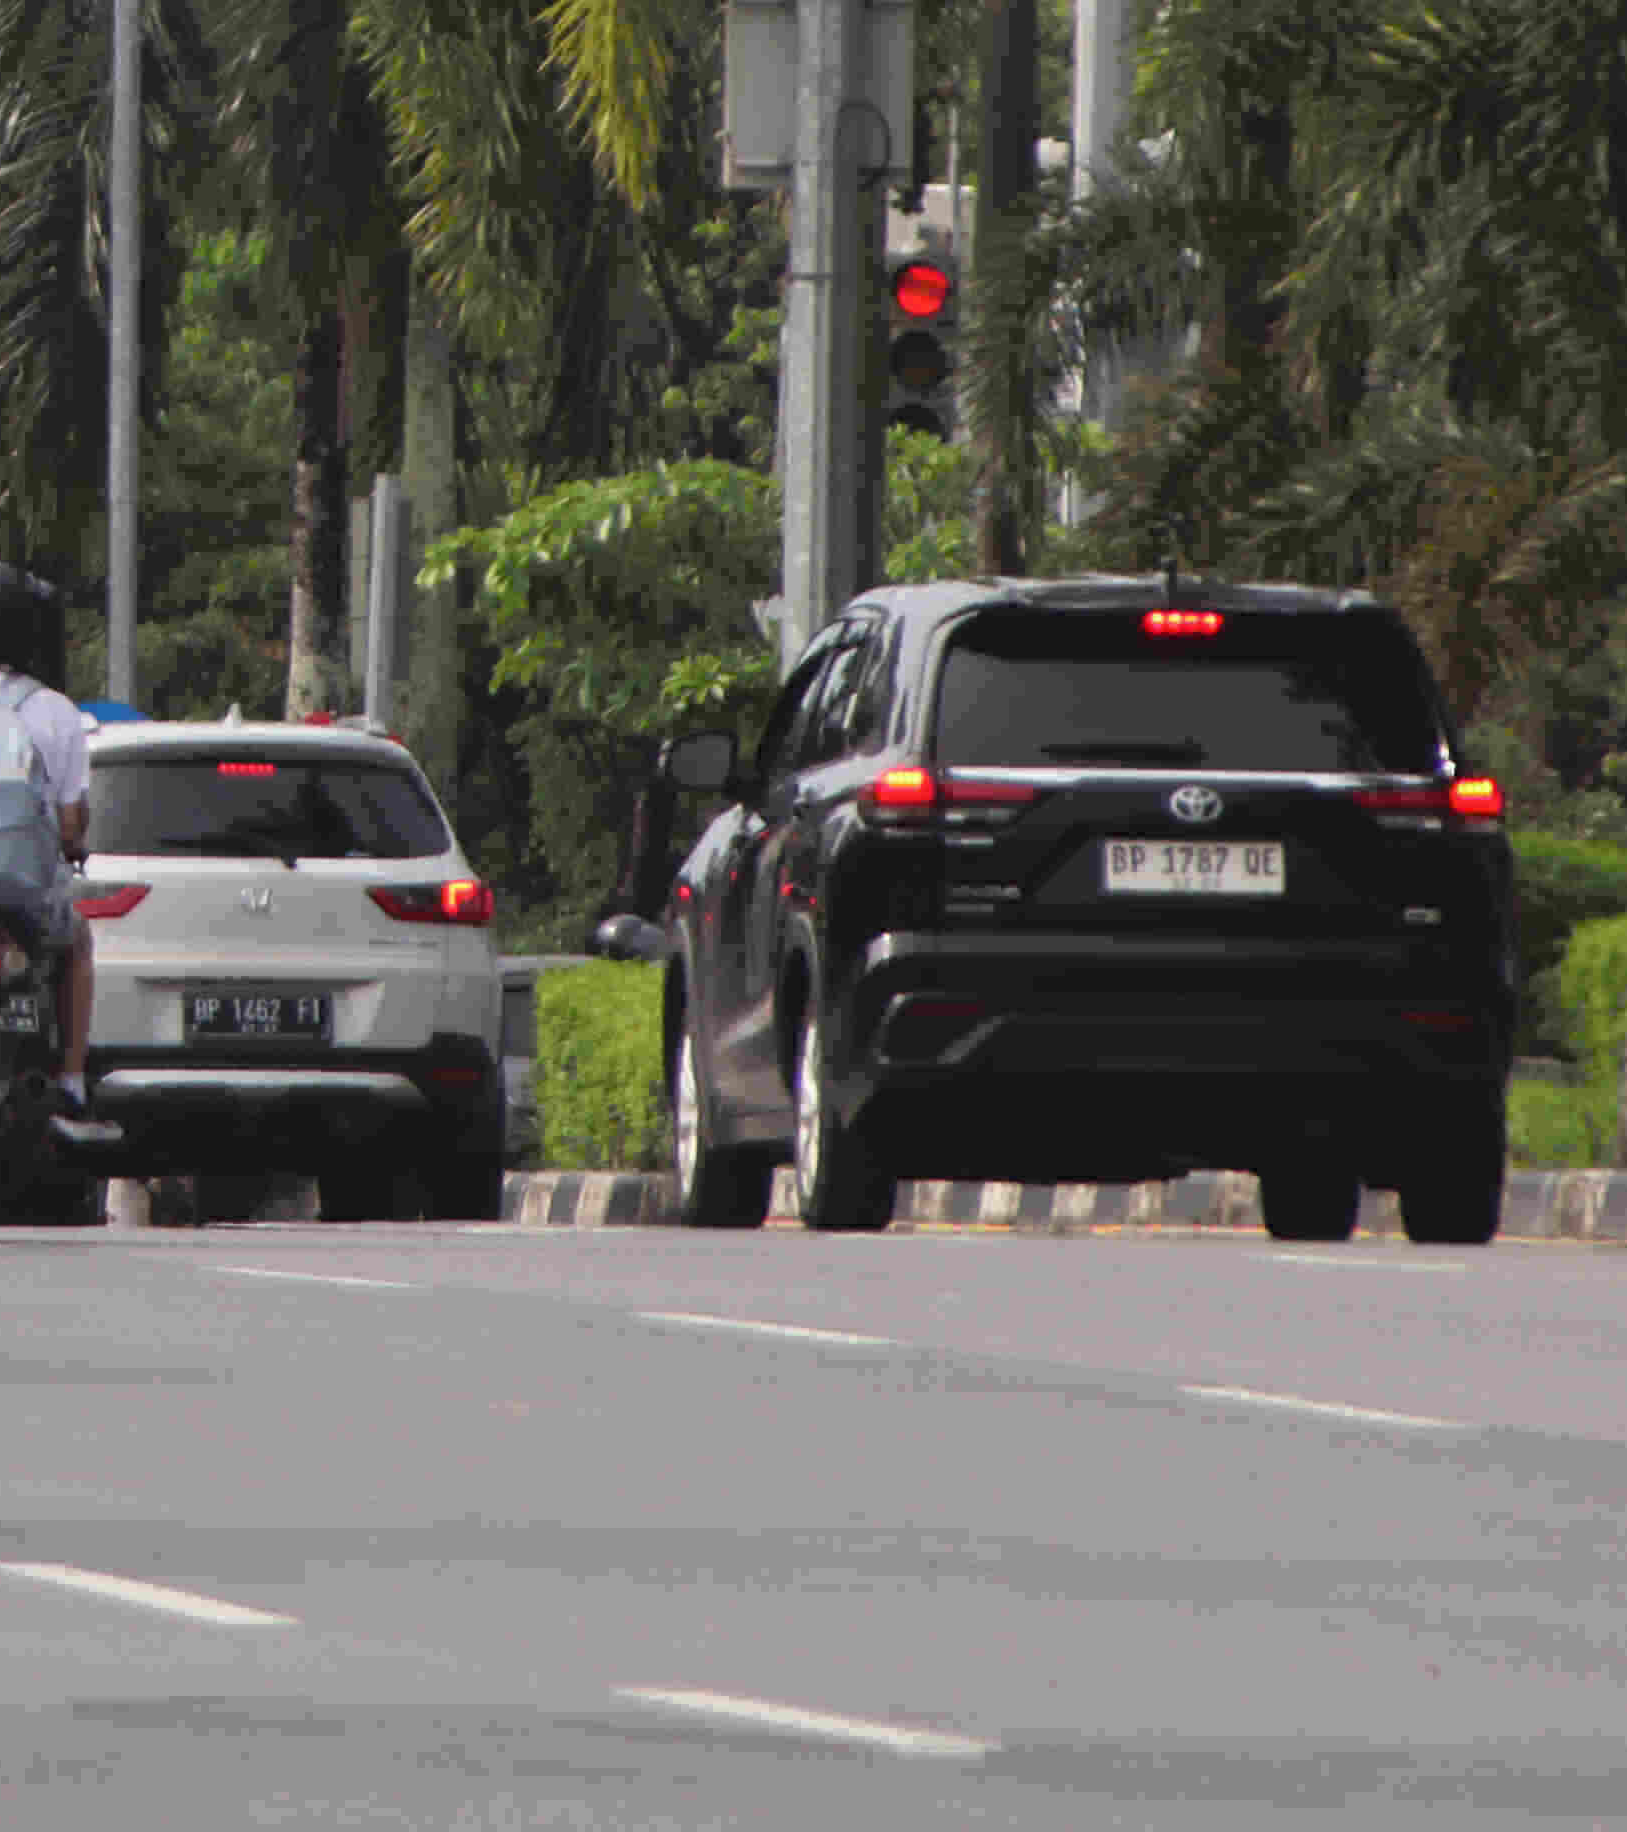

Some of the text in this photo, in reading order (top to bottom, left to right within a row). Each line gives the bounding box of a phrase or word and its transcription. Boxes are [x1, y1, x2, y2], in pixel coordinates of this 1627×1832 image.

[1112, 846, 1145, 874] BP
[1161, 846, 1229, 874] 1787
[195, 997, 221, 1023] BP
